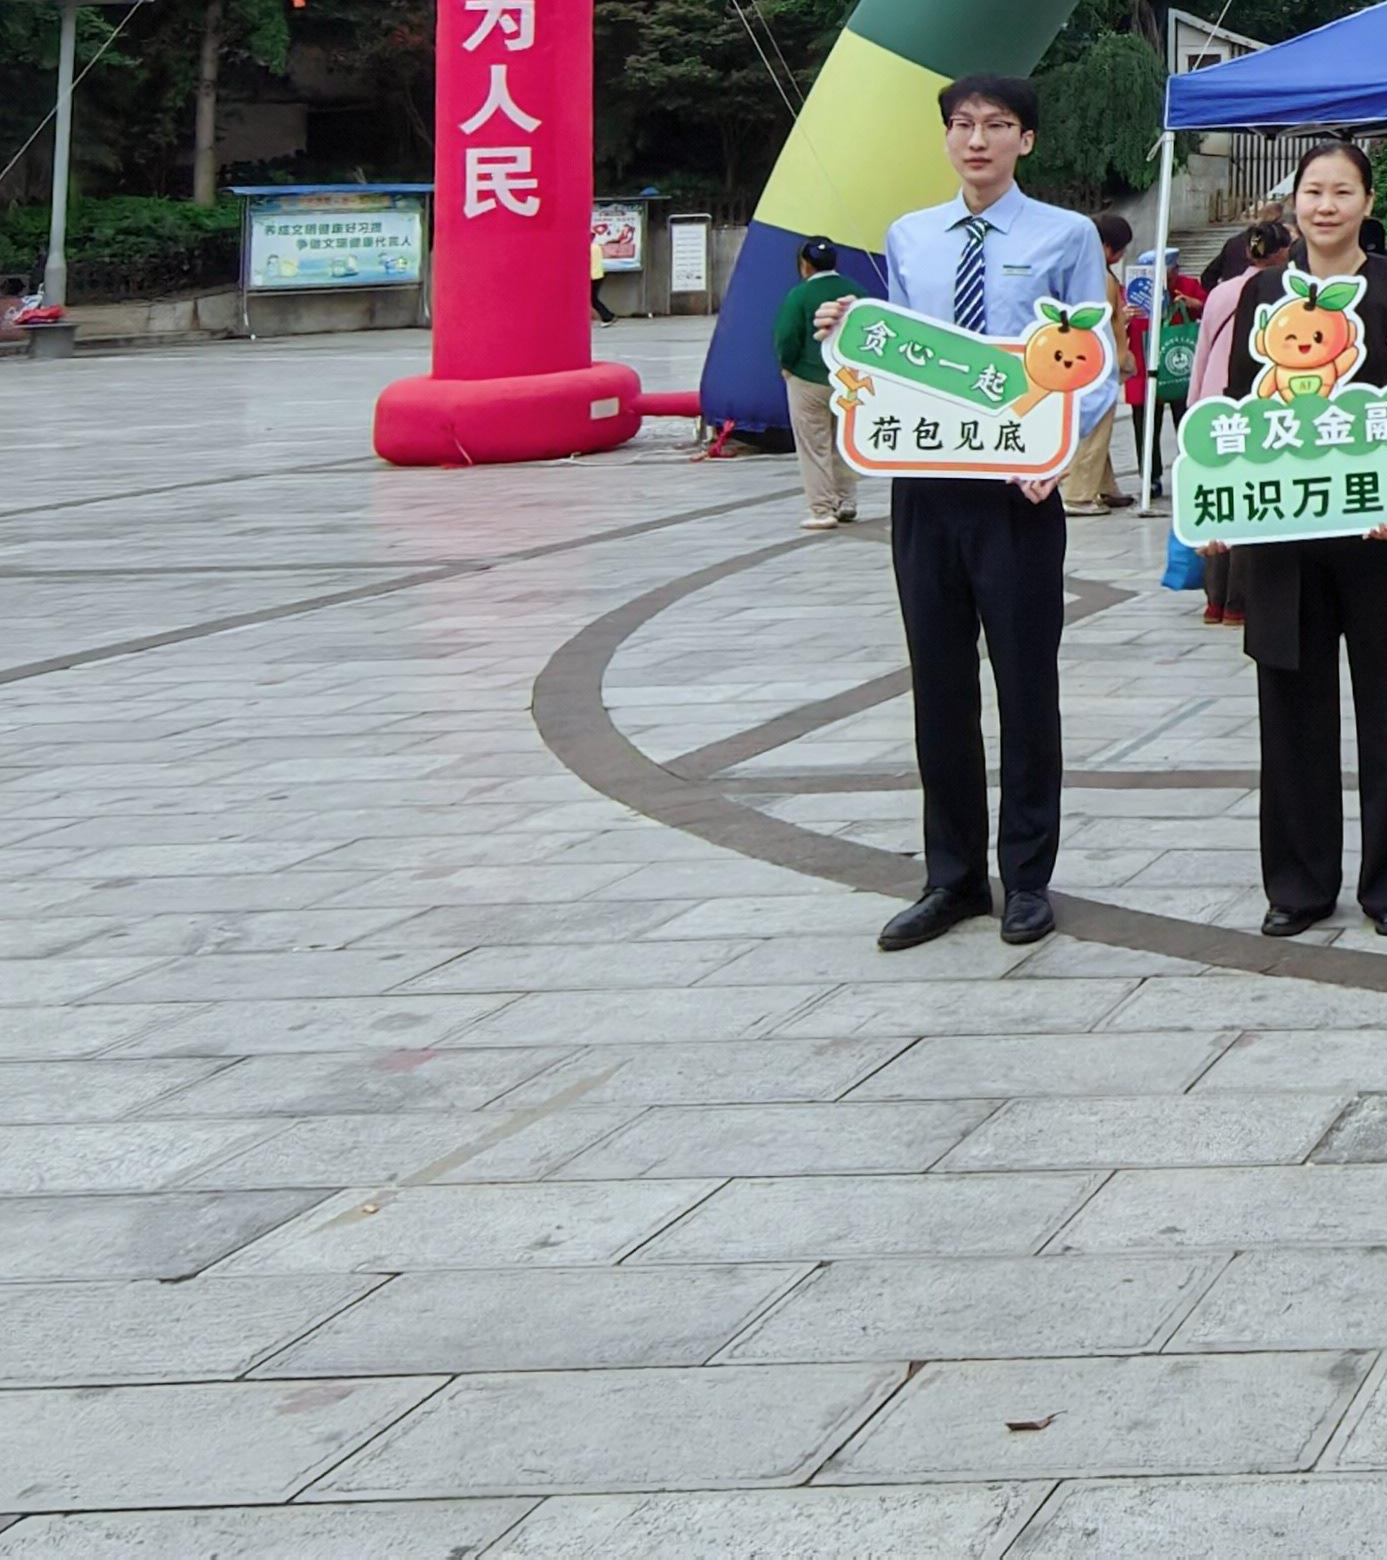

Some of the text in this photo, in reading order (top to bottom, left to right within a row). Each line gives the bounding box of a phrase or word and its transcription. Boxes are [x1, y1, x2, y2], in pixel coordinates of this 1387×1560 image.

[857, 320, 1008, 403] 贪心一起
[868, 415, 1026, 453] 荷包见底
